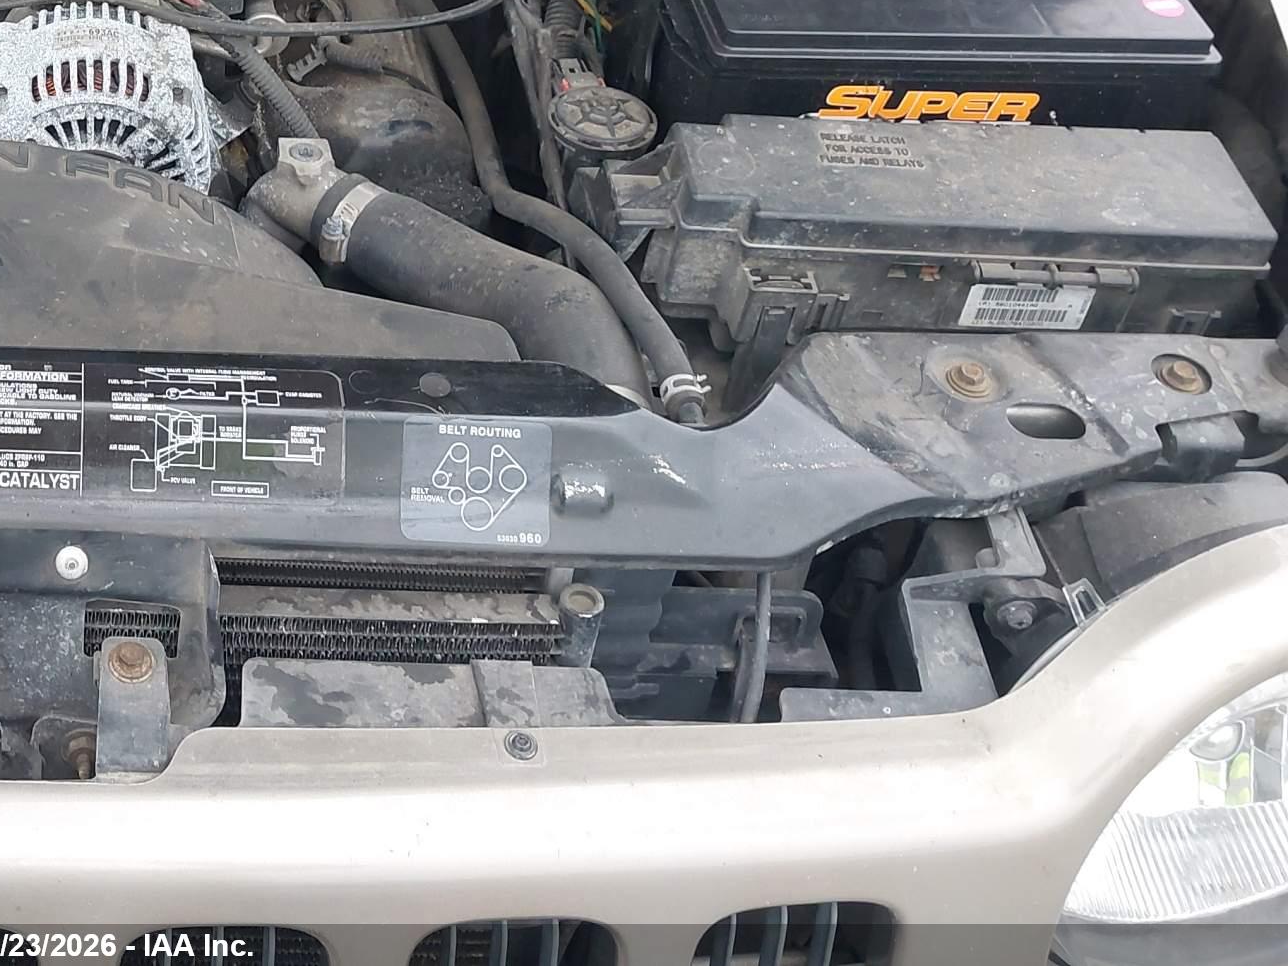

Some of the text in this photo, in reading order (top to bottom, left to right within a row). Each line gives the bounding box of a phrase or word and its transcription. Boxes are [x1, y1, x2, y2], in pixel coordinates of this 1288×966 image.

[818, 84, 1040, 124] SUPER
[820, 132, 906, 145] RELEASE LATCH
[825, 144, 909, 156] FOR ACCESS TO
[820, 155, 925, 168] FUSES AND RELAYS
[65, 152, 215, 224] FAN
[439, 424, 521, 438] BELT ROUTING
[0, 471, 79, 489] CATALYST
[410, 494, 445, 503] REMOVAL
